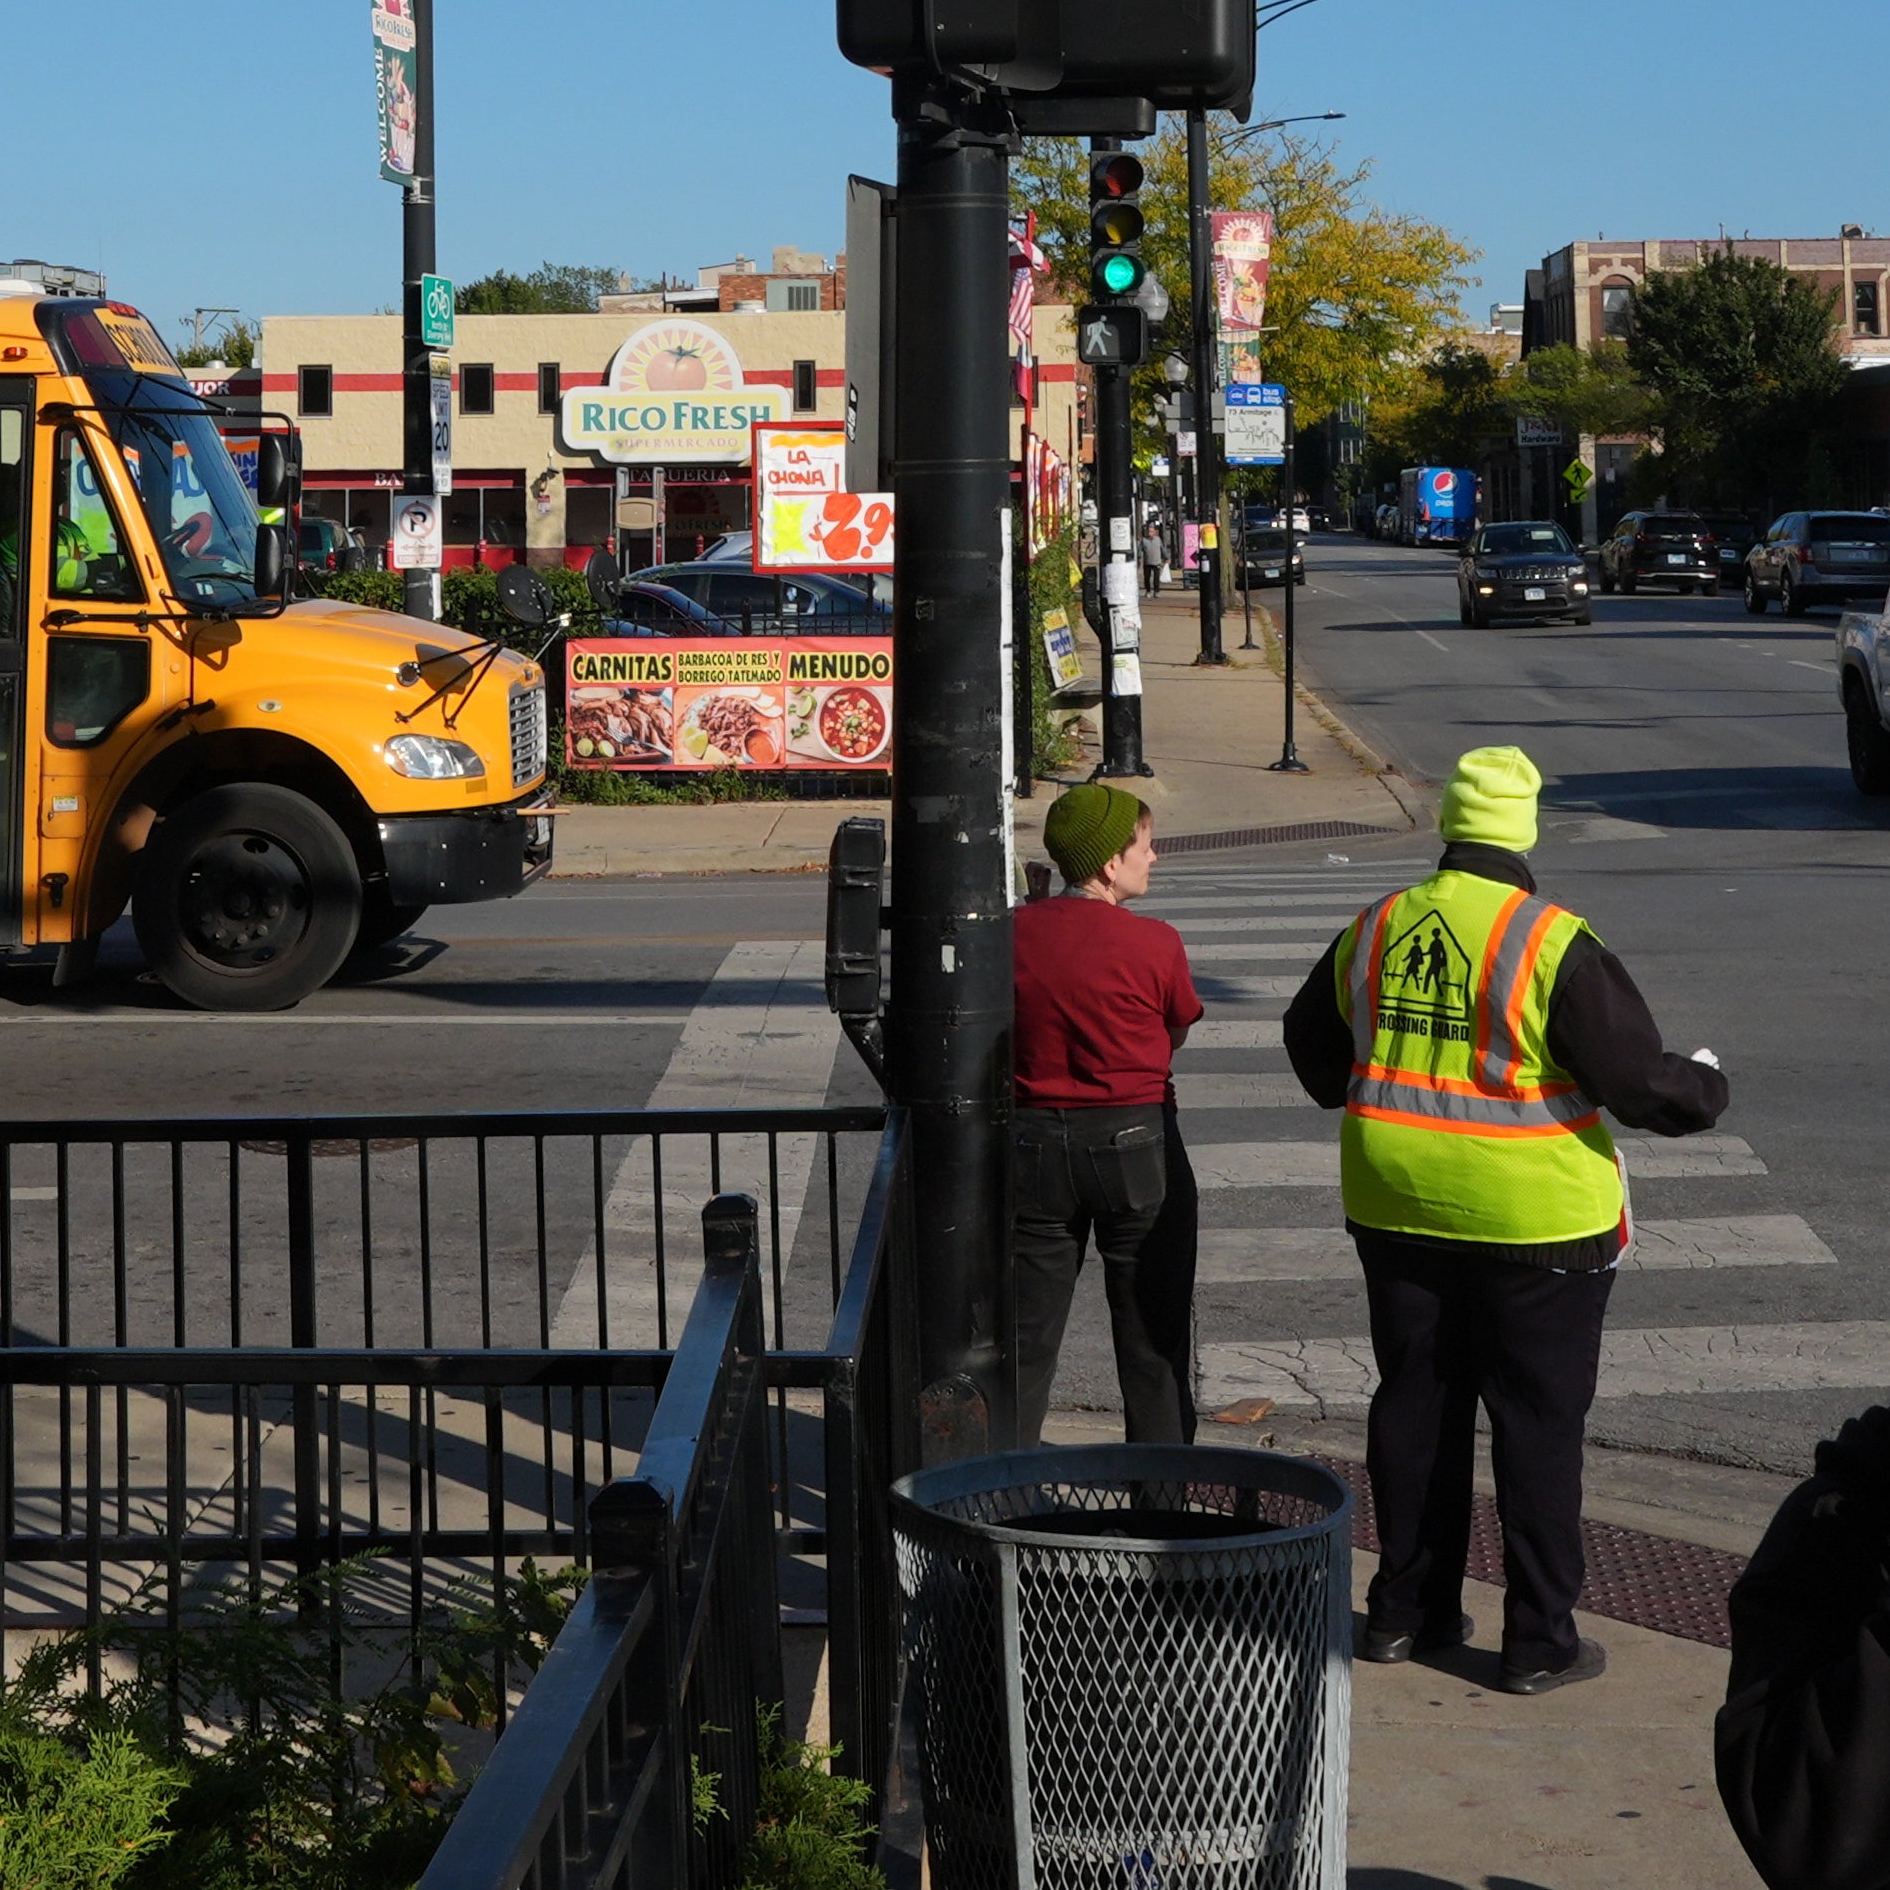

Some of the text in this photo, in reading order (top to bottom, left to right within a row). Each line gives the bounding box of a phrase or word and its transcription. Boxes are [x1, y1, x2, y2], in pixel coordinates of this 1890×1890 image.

[374, 47, 388, 163] WELCOME
[581, 400, 771, 432] RICO FRESH
[435, 420, 450, 452] 20
[614, 436, 739, 449] SUPERMERCADO
[786, 450, 812, 465] LA
[629, 467, 732, 483] TAUERIA
[767, 469, 826, 487] CHONA
[572, 651, 891, 682] CARNITAS BARBACOA DE RES Y MENUDO
[677, 669, 782, 684] BORREGO TATEMADO
[1378, 1012, 1470, 1041] ROSSING GUARD
